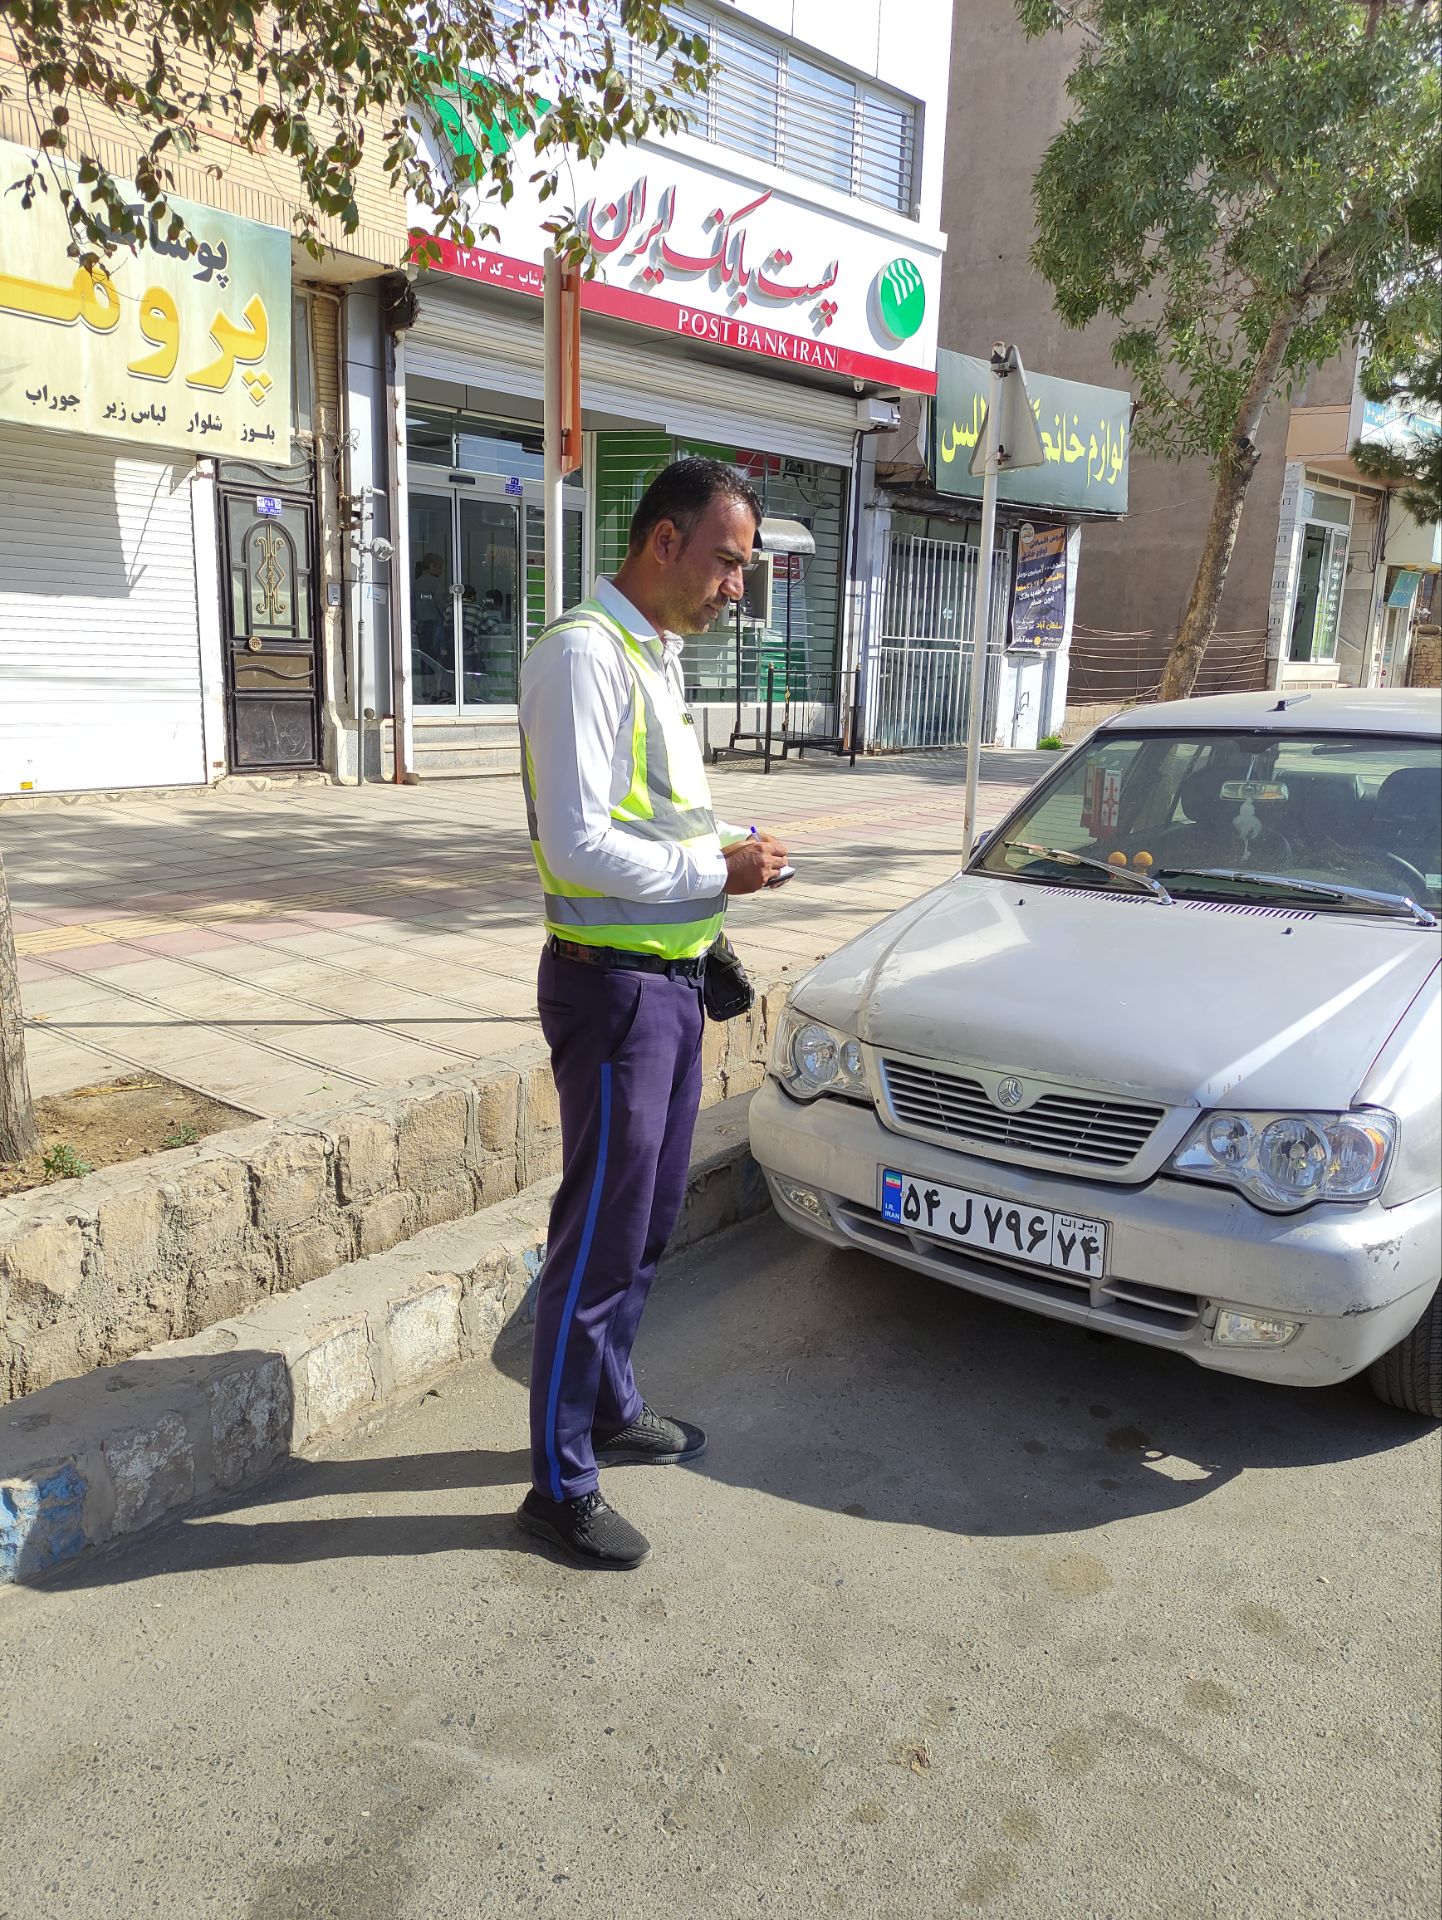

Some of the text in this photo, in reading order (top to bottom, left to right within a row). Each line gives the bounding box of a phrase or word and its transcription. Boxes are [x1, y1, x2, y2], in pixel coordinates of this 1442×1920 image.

[587, 175, 677, 285] ایران
[661, 189, 773, 308] بانک
[489, 262, 504, 276] کد
[677, 308, 837, 369] POST BANK IRAN
[25, 384, 276, 445] بلوز شلوار لباس زیر جوراب
[1086, 418, 1126, 489] لوازم
[884, 1210, 900, 1220] IRAN
[903, 1183, 1048, 1254] ۵۴ ل ۷۹۶
[1061, 1216, 1098, 1234] ایران
[1056, 1229, 1100, 1272] ۷۴
